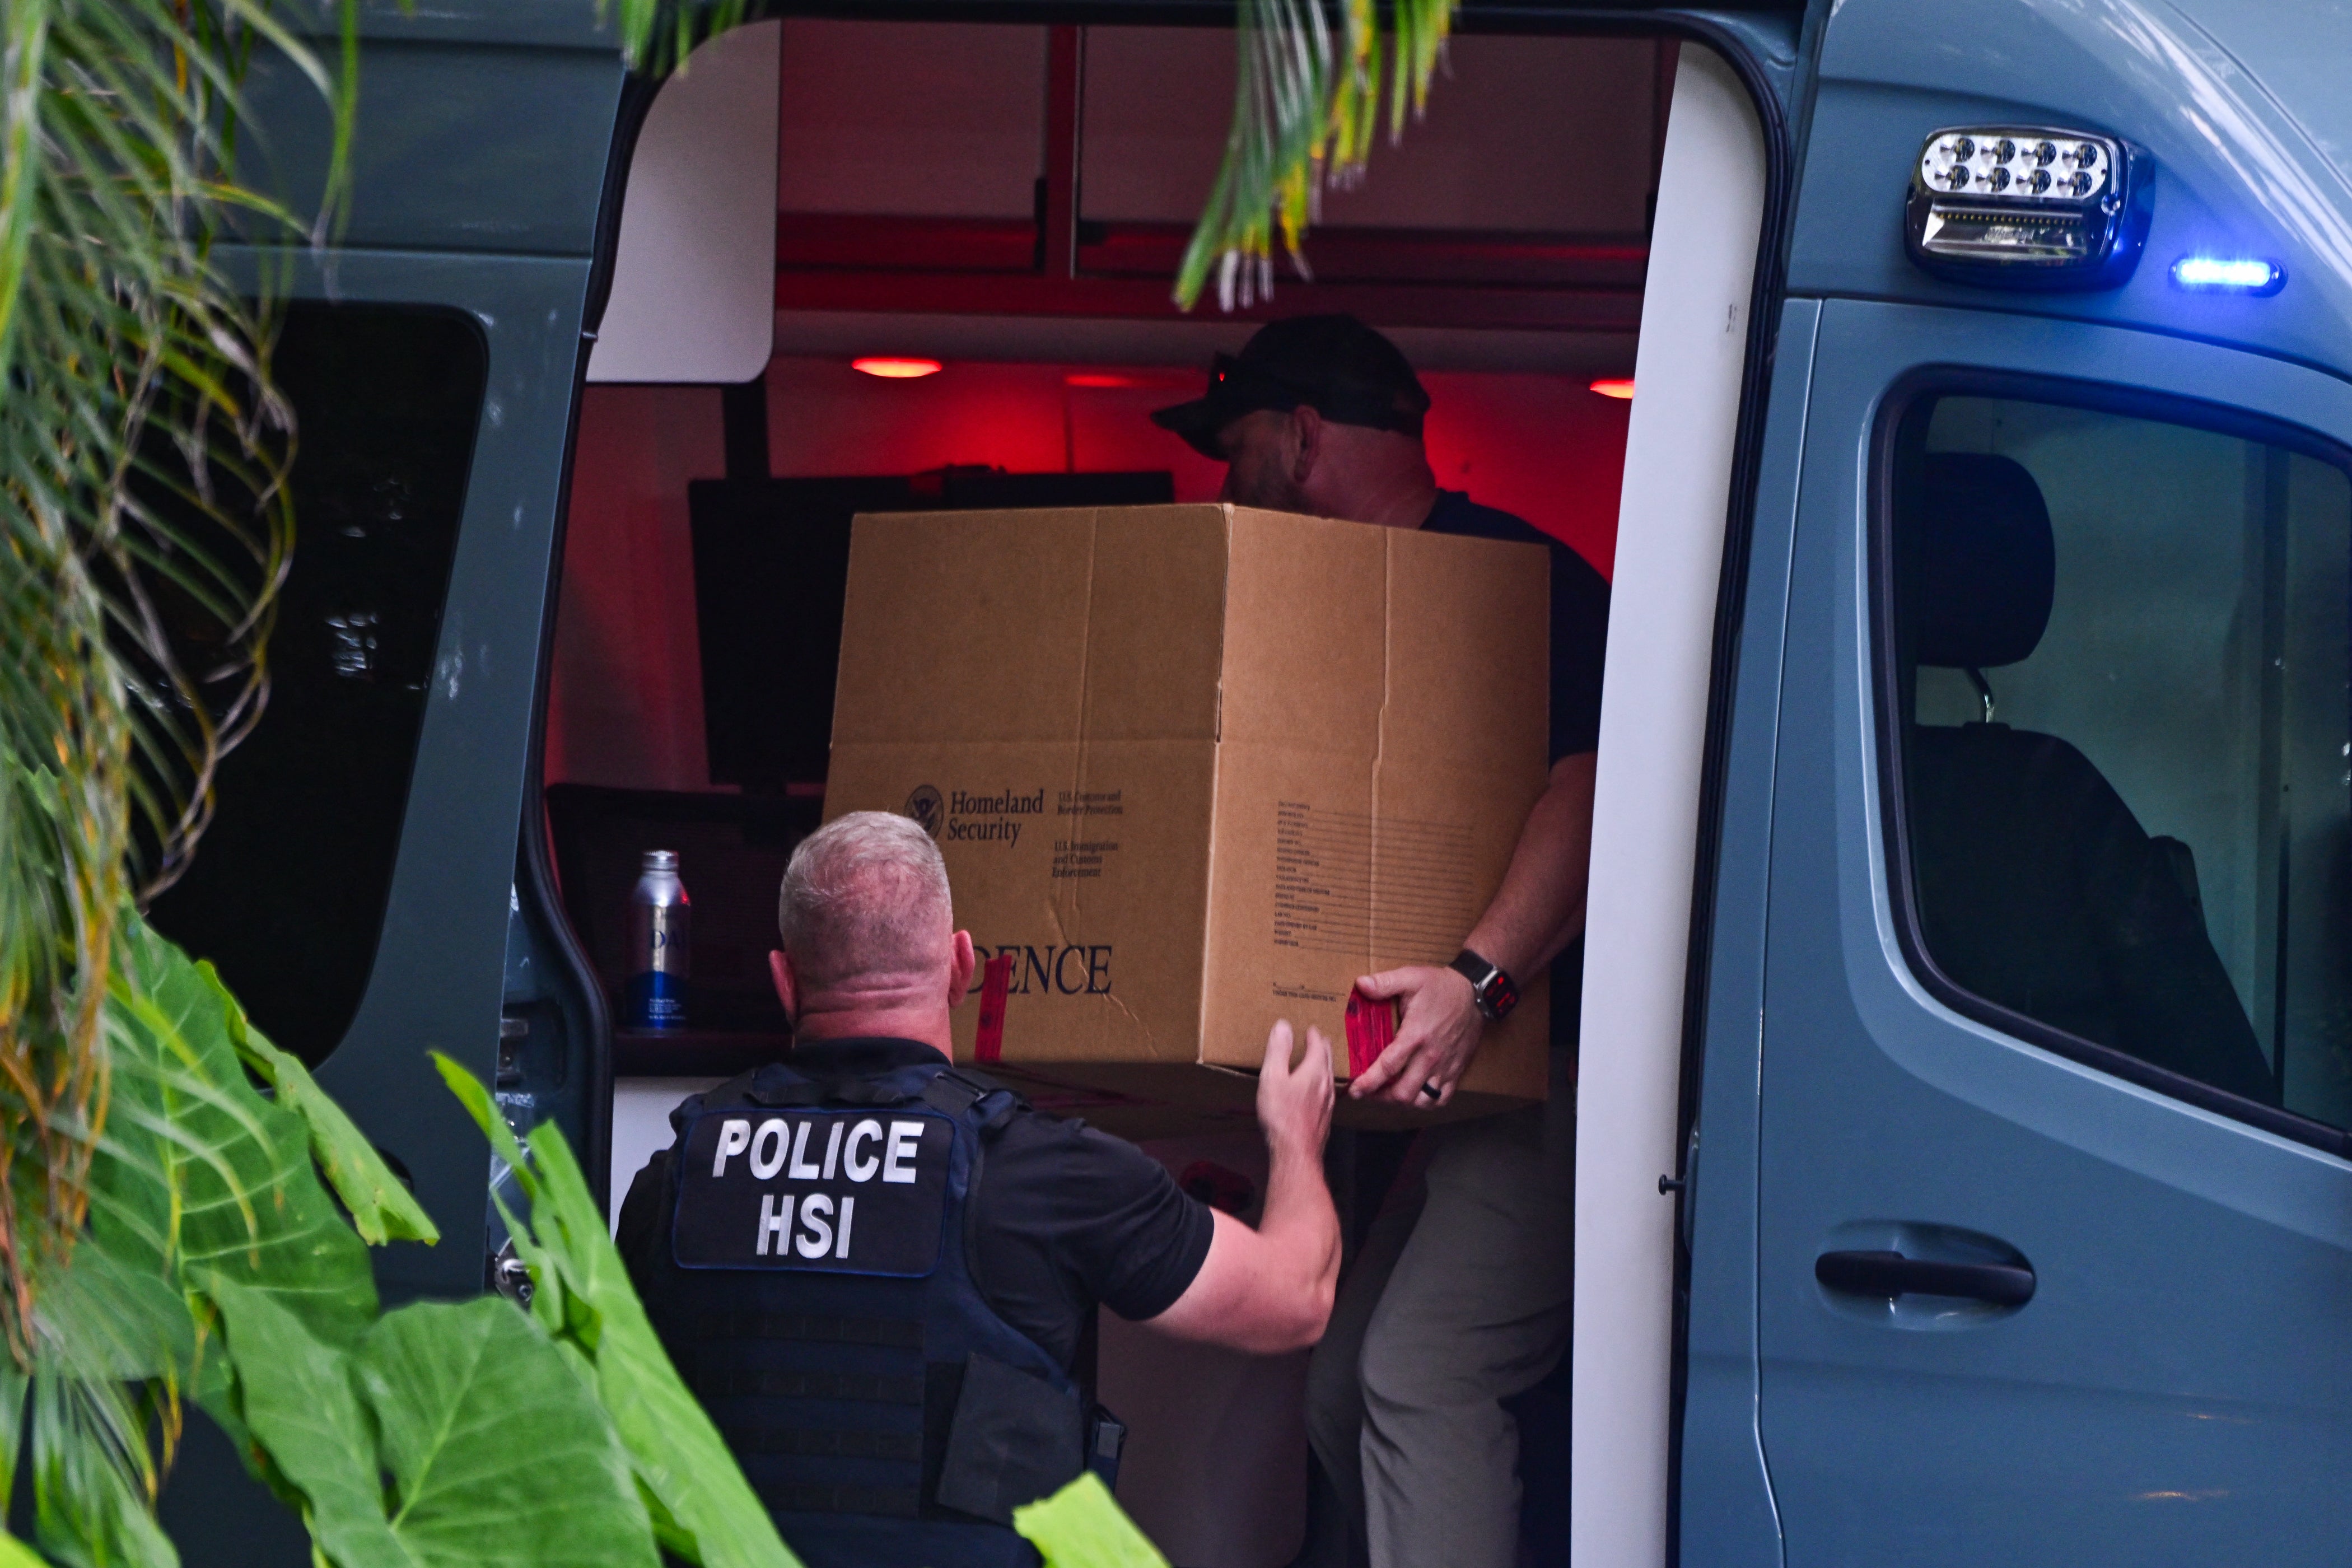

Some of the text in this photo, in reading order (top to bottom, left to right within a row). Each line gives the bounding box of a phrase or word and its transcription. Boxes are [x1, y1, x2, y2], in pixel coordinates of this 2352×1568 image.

[950, 788, 1043, 814] Homeland
[947, 816, 1021, 848] Security
[712, 1118, 925, 1183] POLICE
[756, 1193, 855, 1259] HSI
